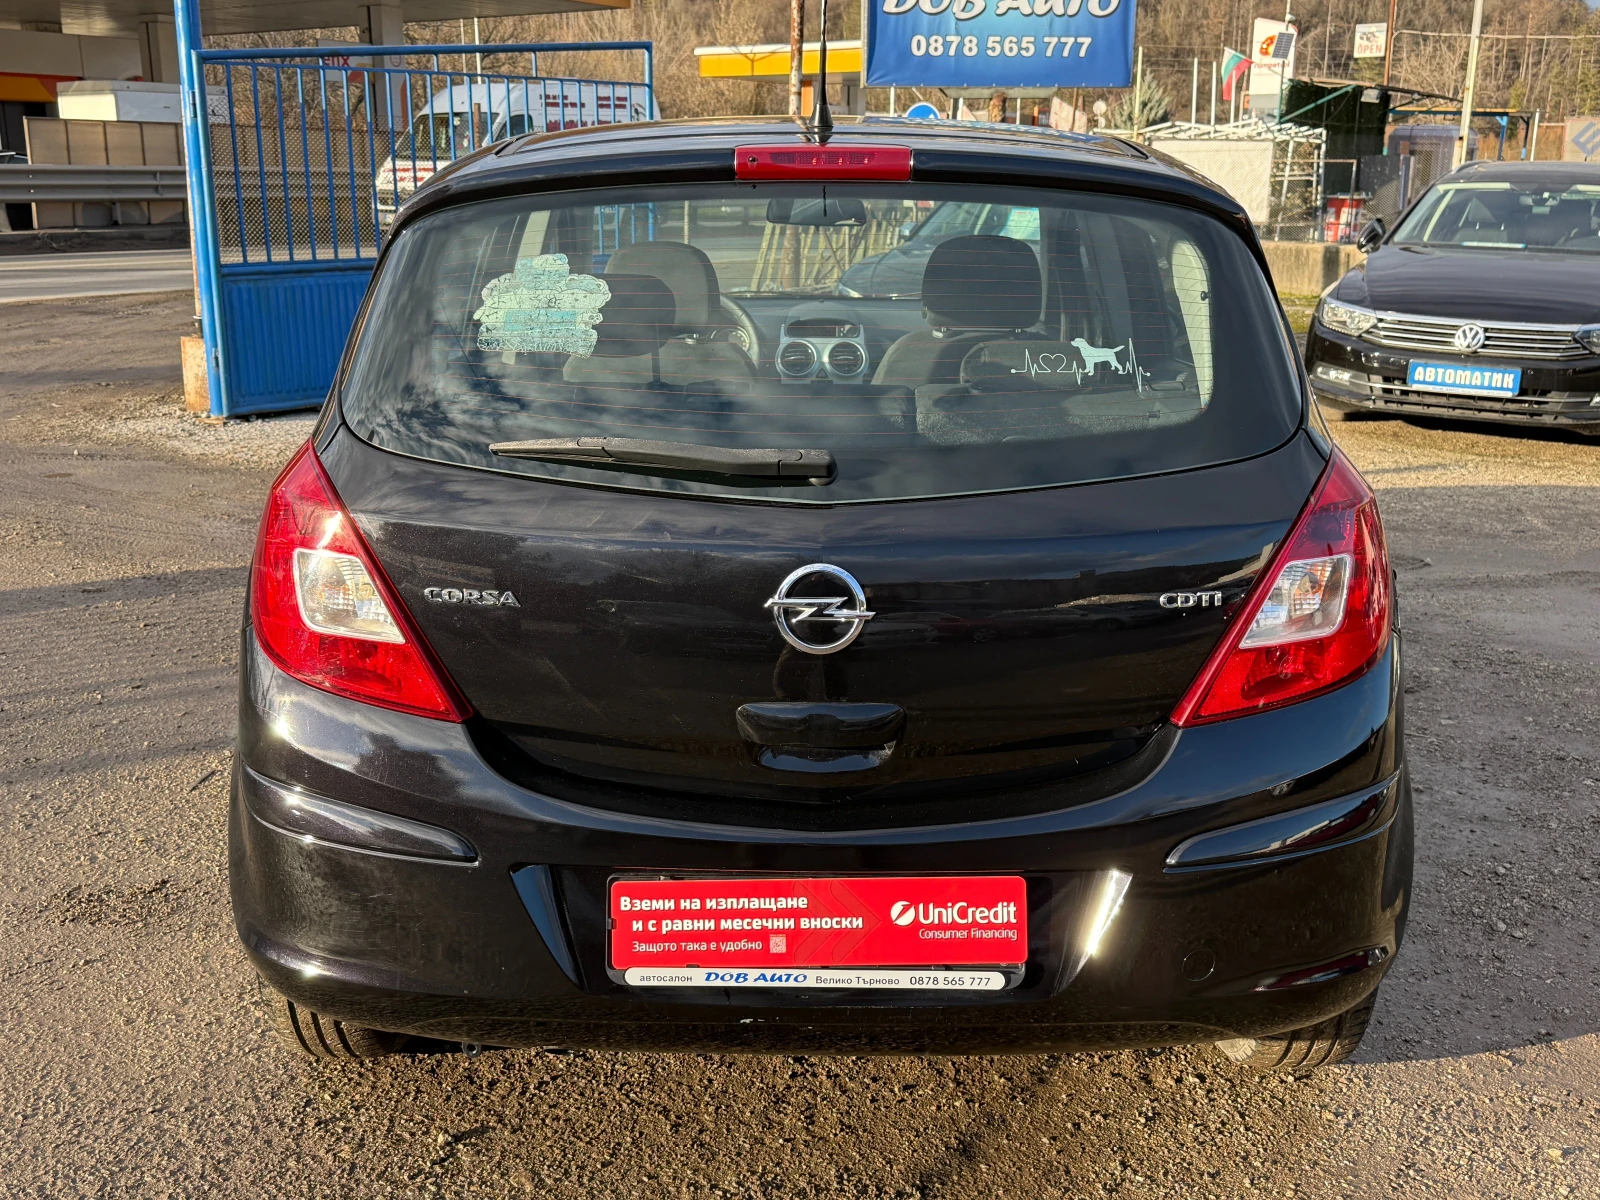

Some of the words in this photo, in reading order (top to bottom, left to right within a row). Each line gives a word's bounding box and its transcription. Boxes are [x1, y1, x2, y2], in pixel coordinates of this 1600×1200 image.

[910, 34, 979, 57] 0878
[985, 36, 1036, 57] 565
[1042, 36, 1092, 58] 777
[1357, 43, 1383, 55] OPEN
[1413, 366, 1515, 389] АВТОМАТИК
[423, 587, 522, 608] CORSA
[619, 896, 675, 911] Вземи
[680, 898, 701, 910] на
[705, 897, 808, 911] изплащане
[918, 901, 1018, 925] UniCredit
[632, 919, 643, 932] и
[648, 919, 658, 931] с
[661, 918, 715, 934] равни
[720, 917, 795, 930] месечни
[800, 916, 863, 929] вноски
[918, 928, 969, 940] Consumer
[971, 928, 1018, 941] Financing
[632, 941, 677, 953] Защото
[680, 941, 708, 951] така
[710, 942, 717, 951] е
[720, 939, 763, 952] удобно
[639, 975, 693, 983] автосалон
[704, 972, 749, 984] DOB
[815, 975, 853, 986] Велико
[855, 976, 900, 987] Търново
[909, 976, 939, 986] 0878
[943, 977, 965, 987] 565
[969, 977, 991, 987] 777
